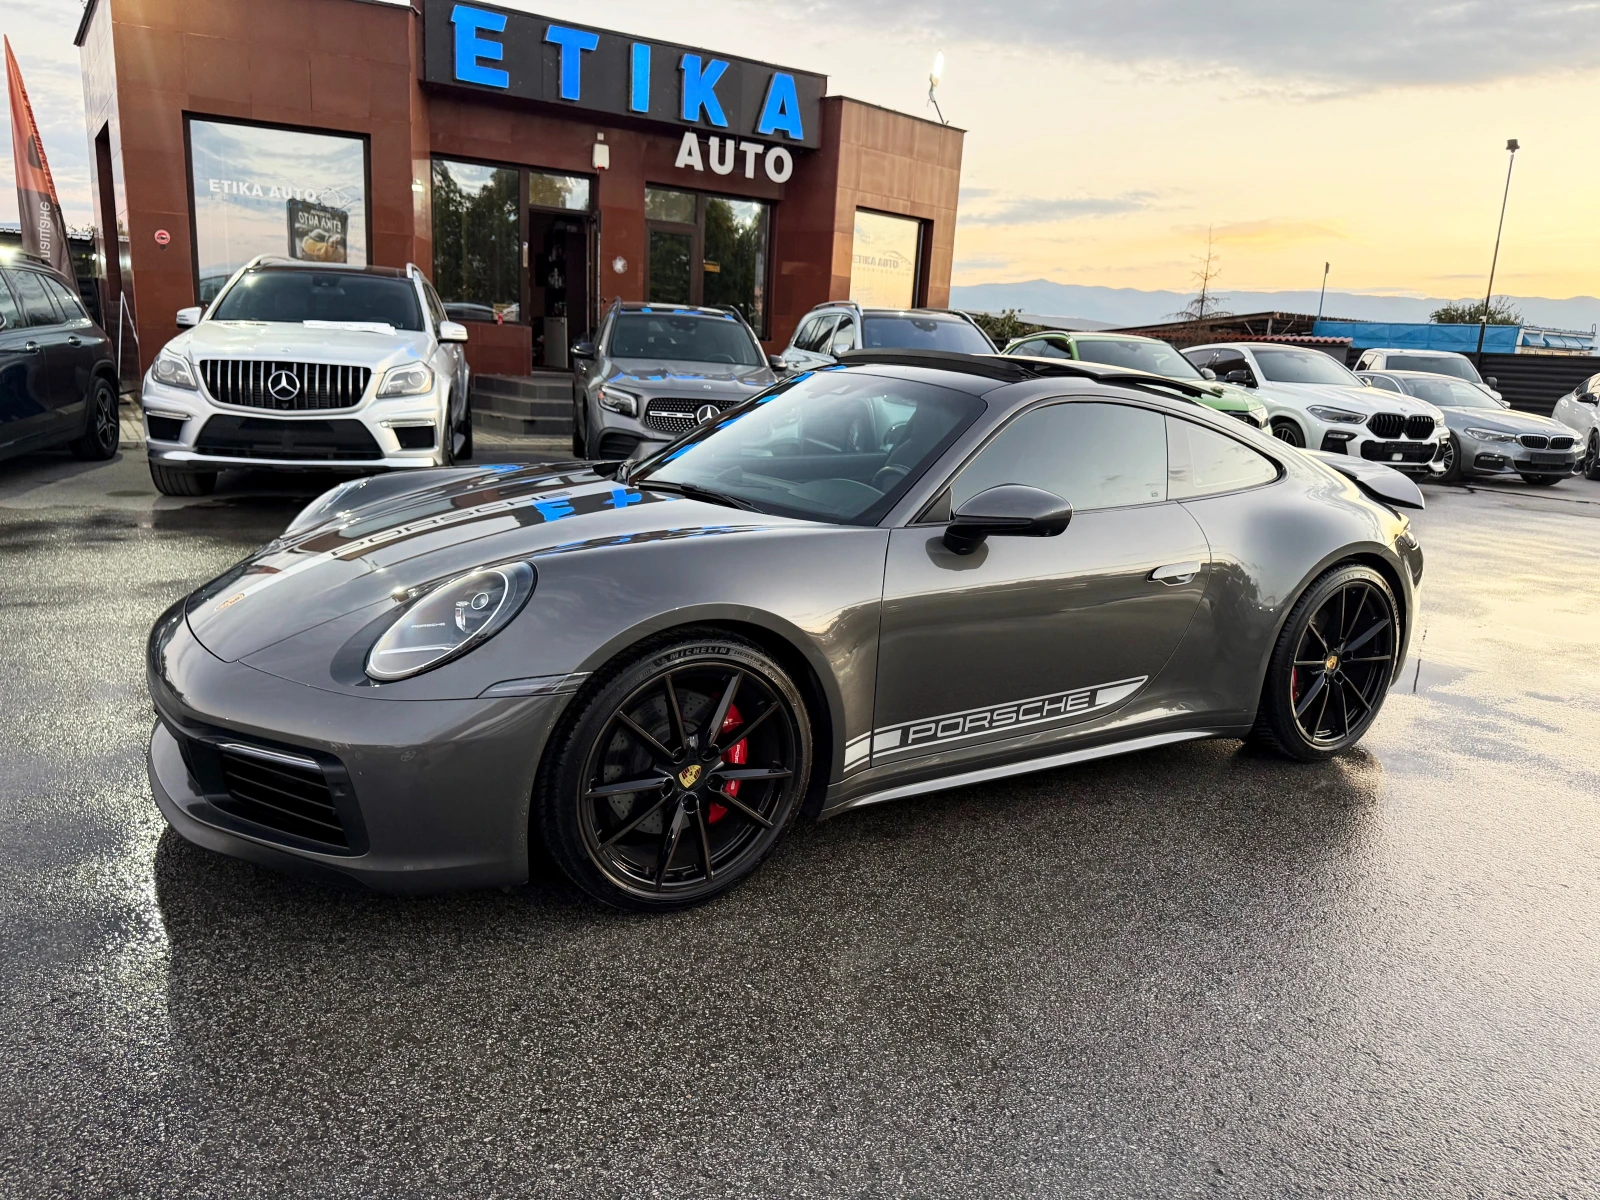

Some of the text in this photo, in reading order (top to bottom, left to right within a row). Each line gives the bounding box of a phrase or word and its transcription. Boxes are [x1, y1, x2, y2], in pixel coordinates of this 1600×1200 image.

[450, 4, 804, 141] ETIKA
[674, 131, 794, 184] AUTO
[208, 178, 264, 197] ETIKA
[269, 186, 318, 202] AUTO
[877, 257, 900, 269] AUTO
[330, 490, 573, 558] PORSCHE
[669, 646, 728, 660] MICHELIN
[907, 691, 1091, 744] PORSCHE
